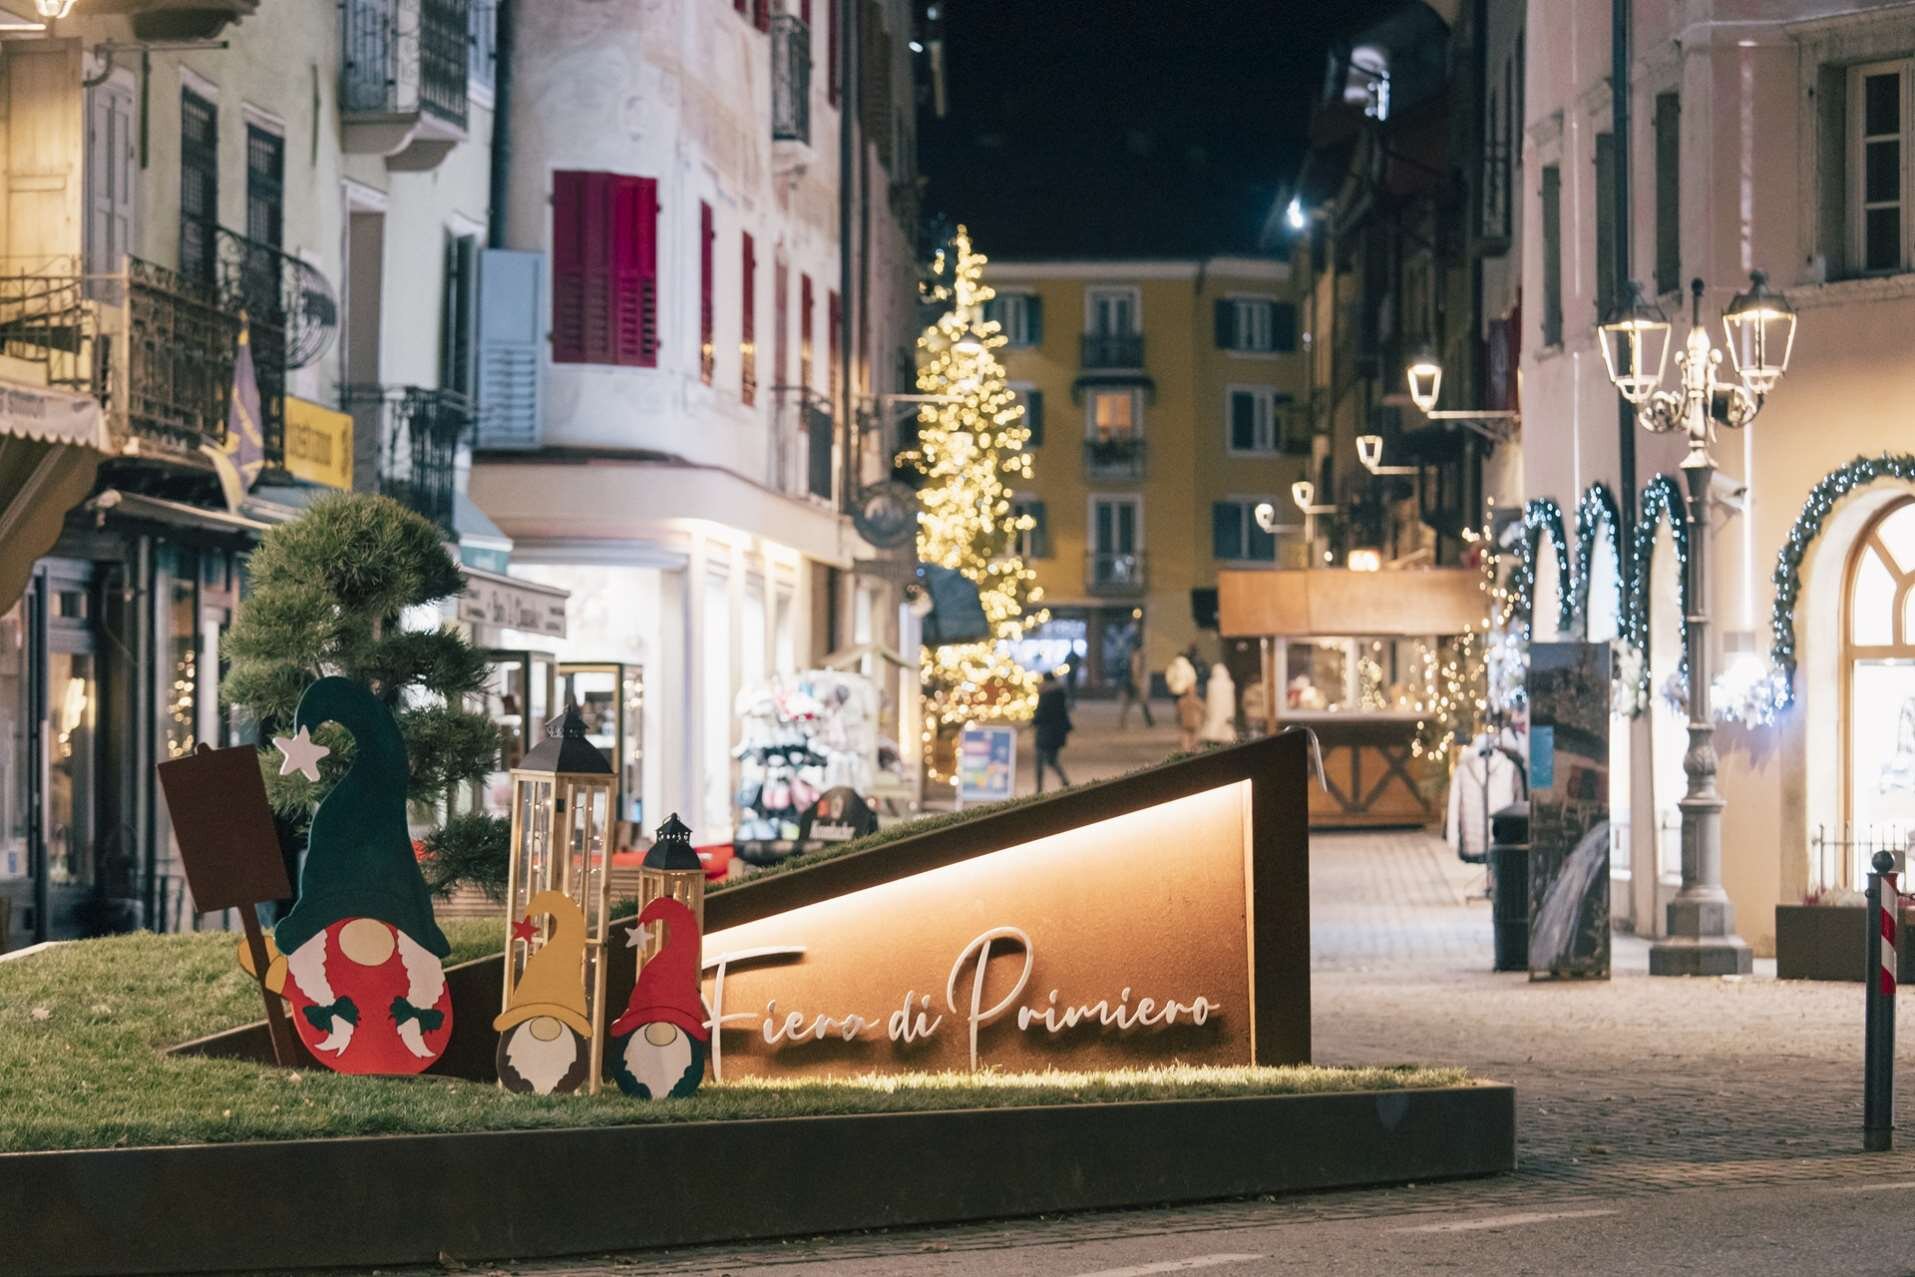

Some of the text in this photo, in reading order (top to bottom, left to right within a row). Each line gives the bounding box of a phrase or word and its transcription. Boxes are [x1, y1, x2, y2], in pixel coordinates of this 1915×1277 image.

[701, 926, 1220, 1082] Fiera di Primiero
